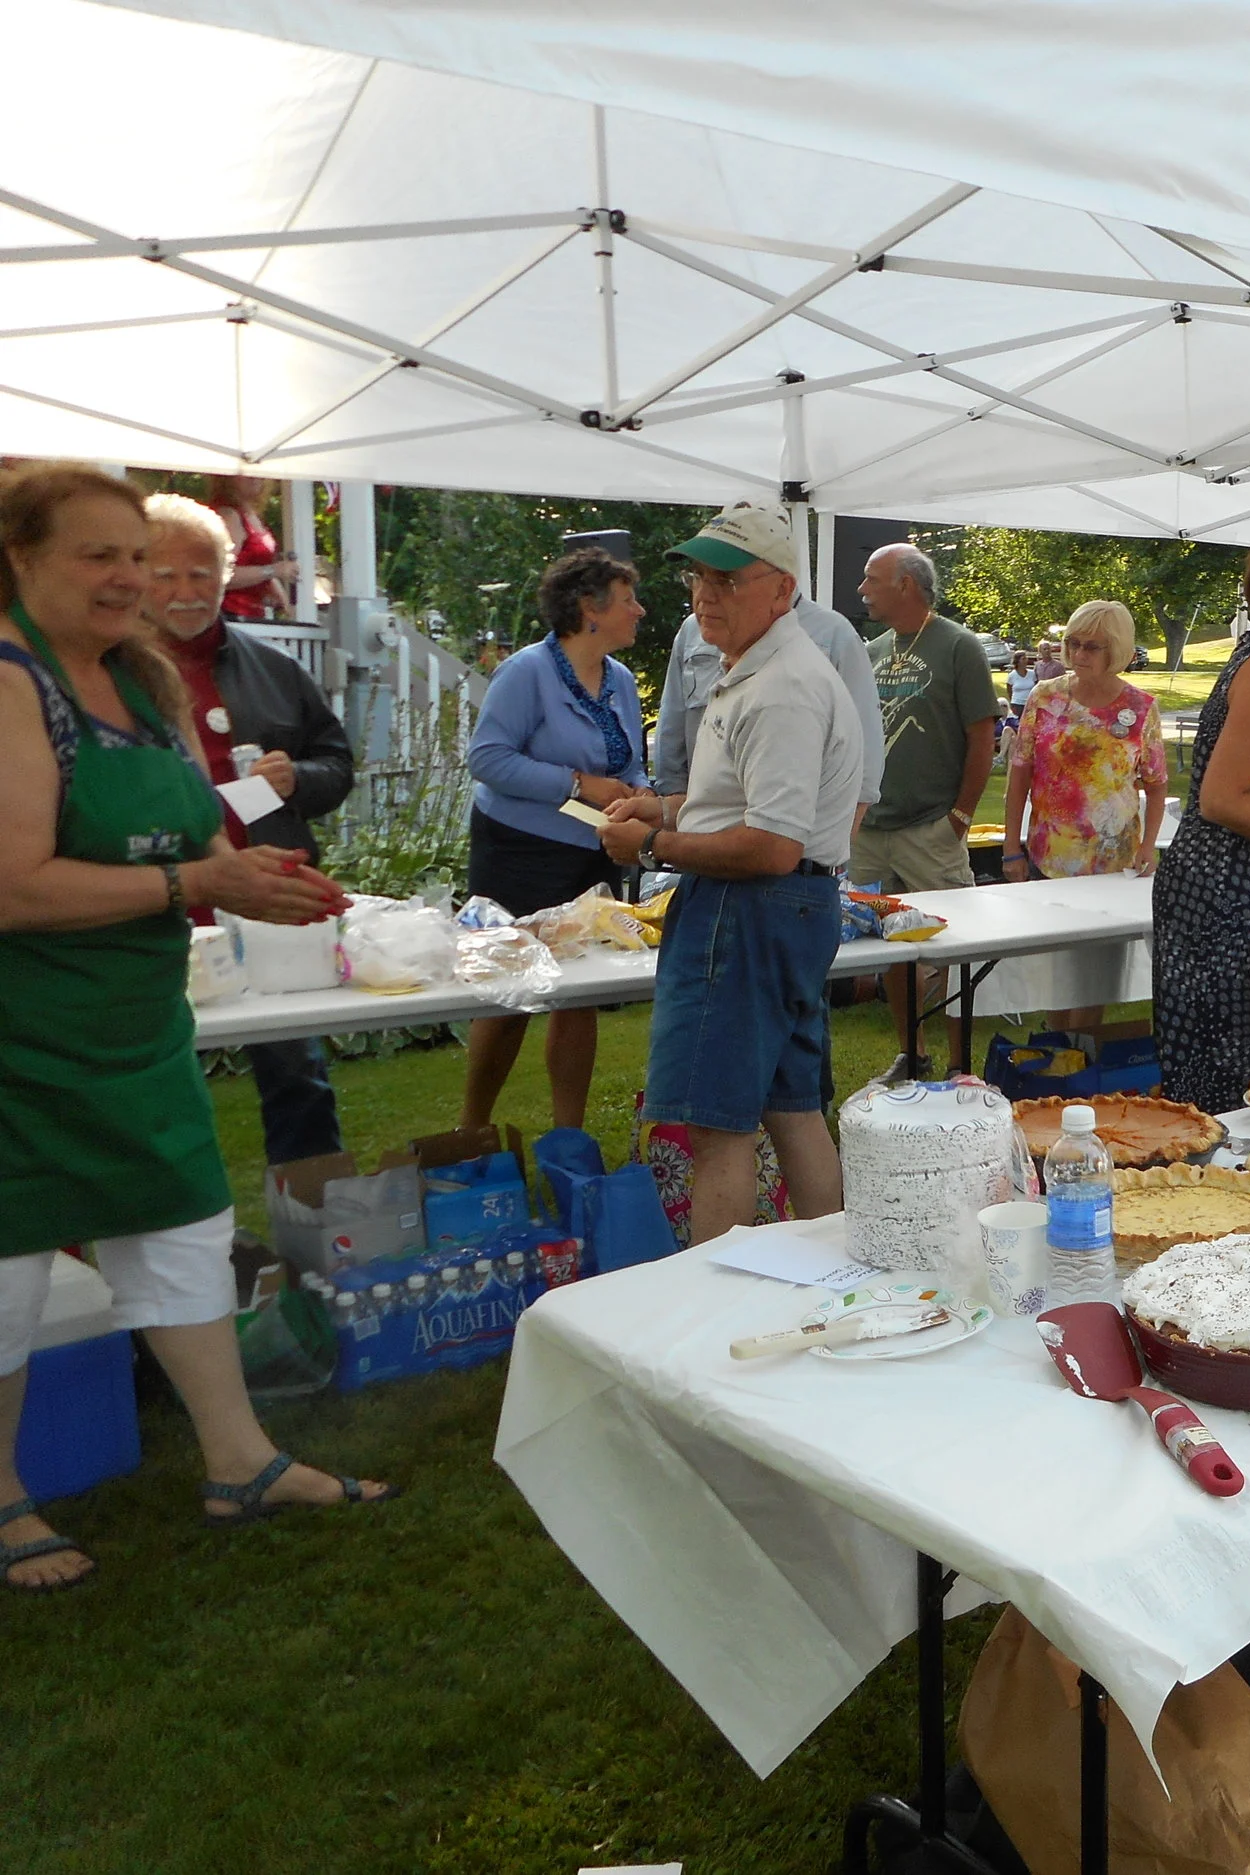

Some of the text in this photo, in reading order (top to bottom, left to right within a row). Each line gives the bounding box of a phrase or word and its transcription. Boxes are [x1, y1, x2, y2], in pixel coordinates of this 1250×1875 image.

[484, 1193, 499, 1218] 24
[551, 1265, 572, 1282] 32
[413, 1286, 527, 1355] AQUAFINA
